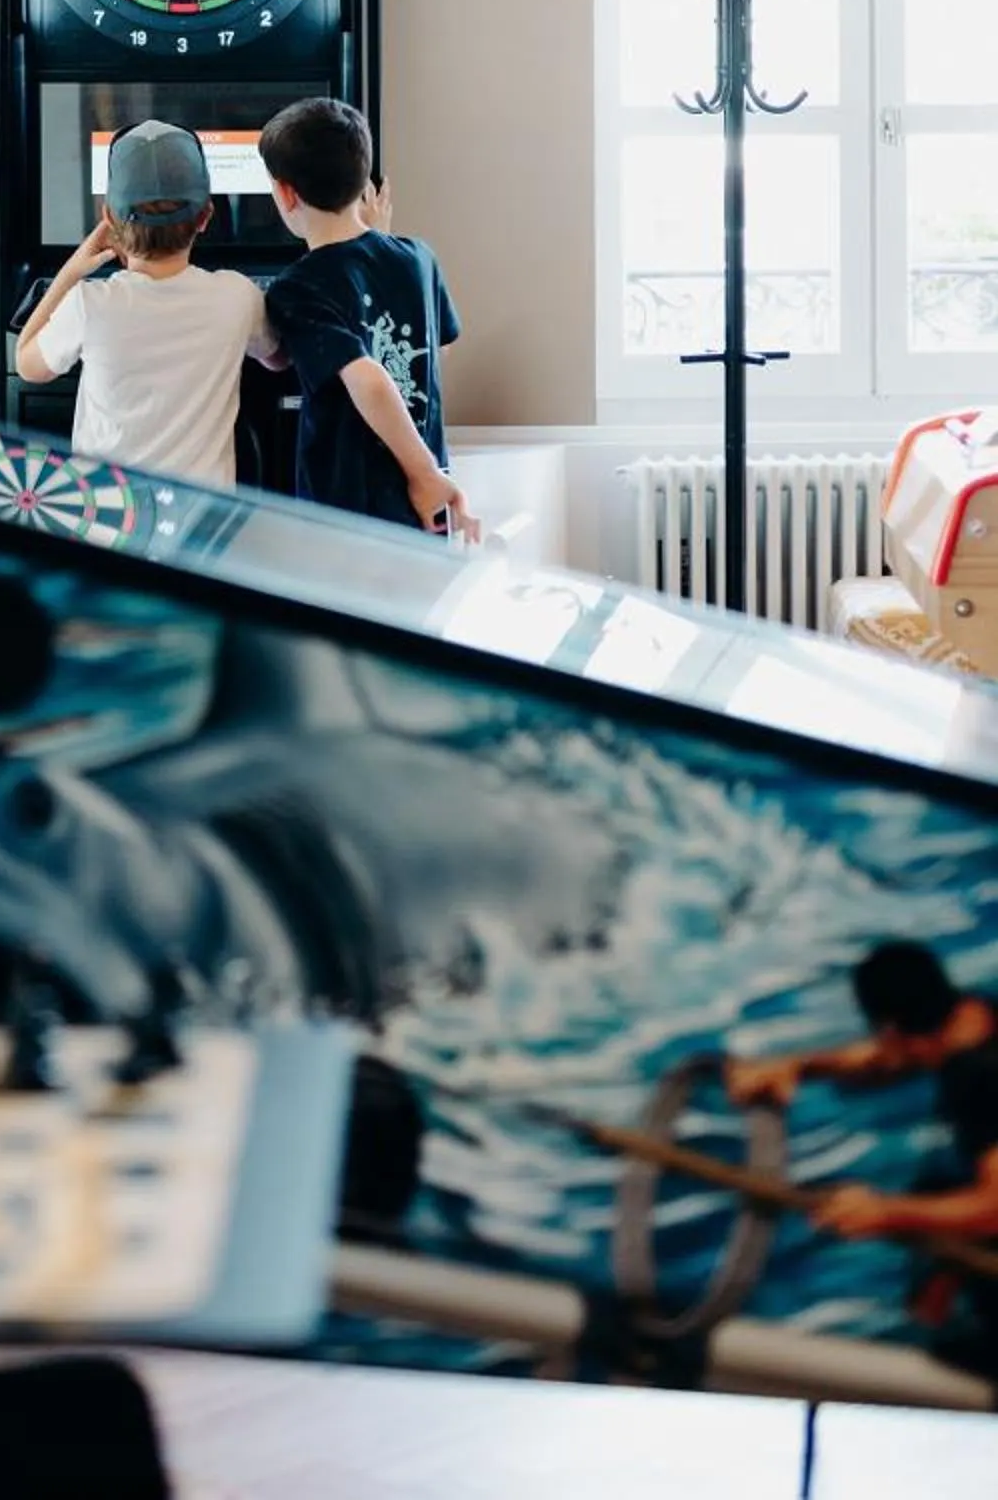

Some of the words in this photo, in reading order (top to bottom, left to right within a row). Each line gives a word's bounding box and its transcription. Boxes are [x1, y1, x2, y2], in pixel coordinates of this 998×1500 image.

[93, 10, 105, 26] 7
[260, 10, 272, 27] 2
[129, 30, 147, 46] 19
[177, 37, 188, 53] 3
[217, 31, 235, 46] 17
